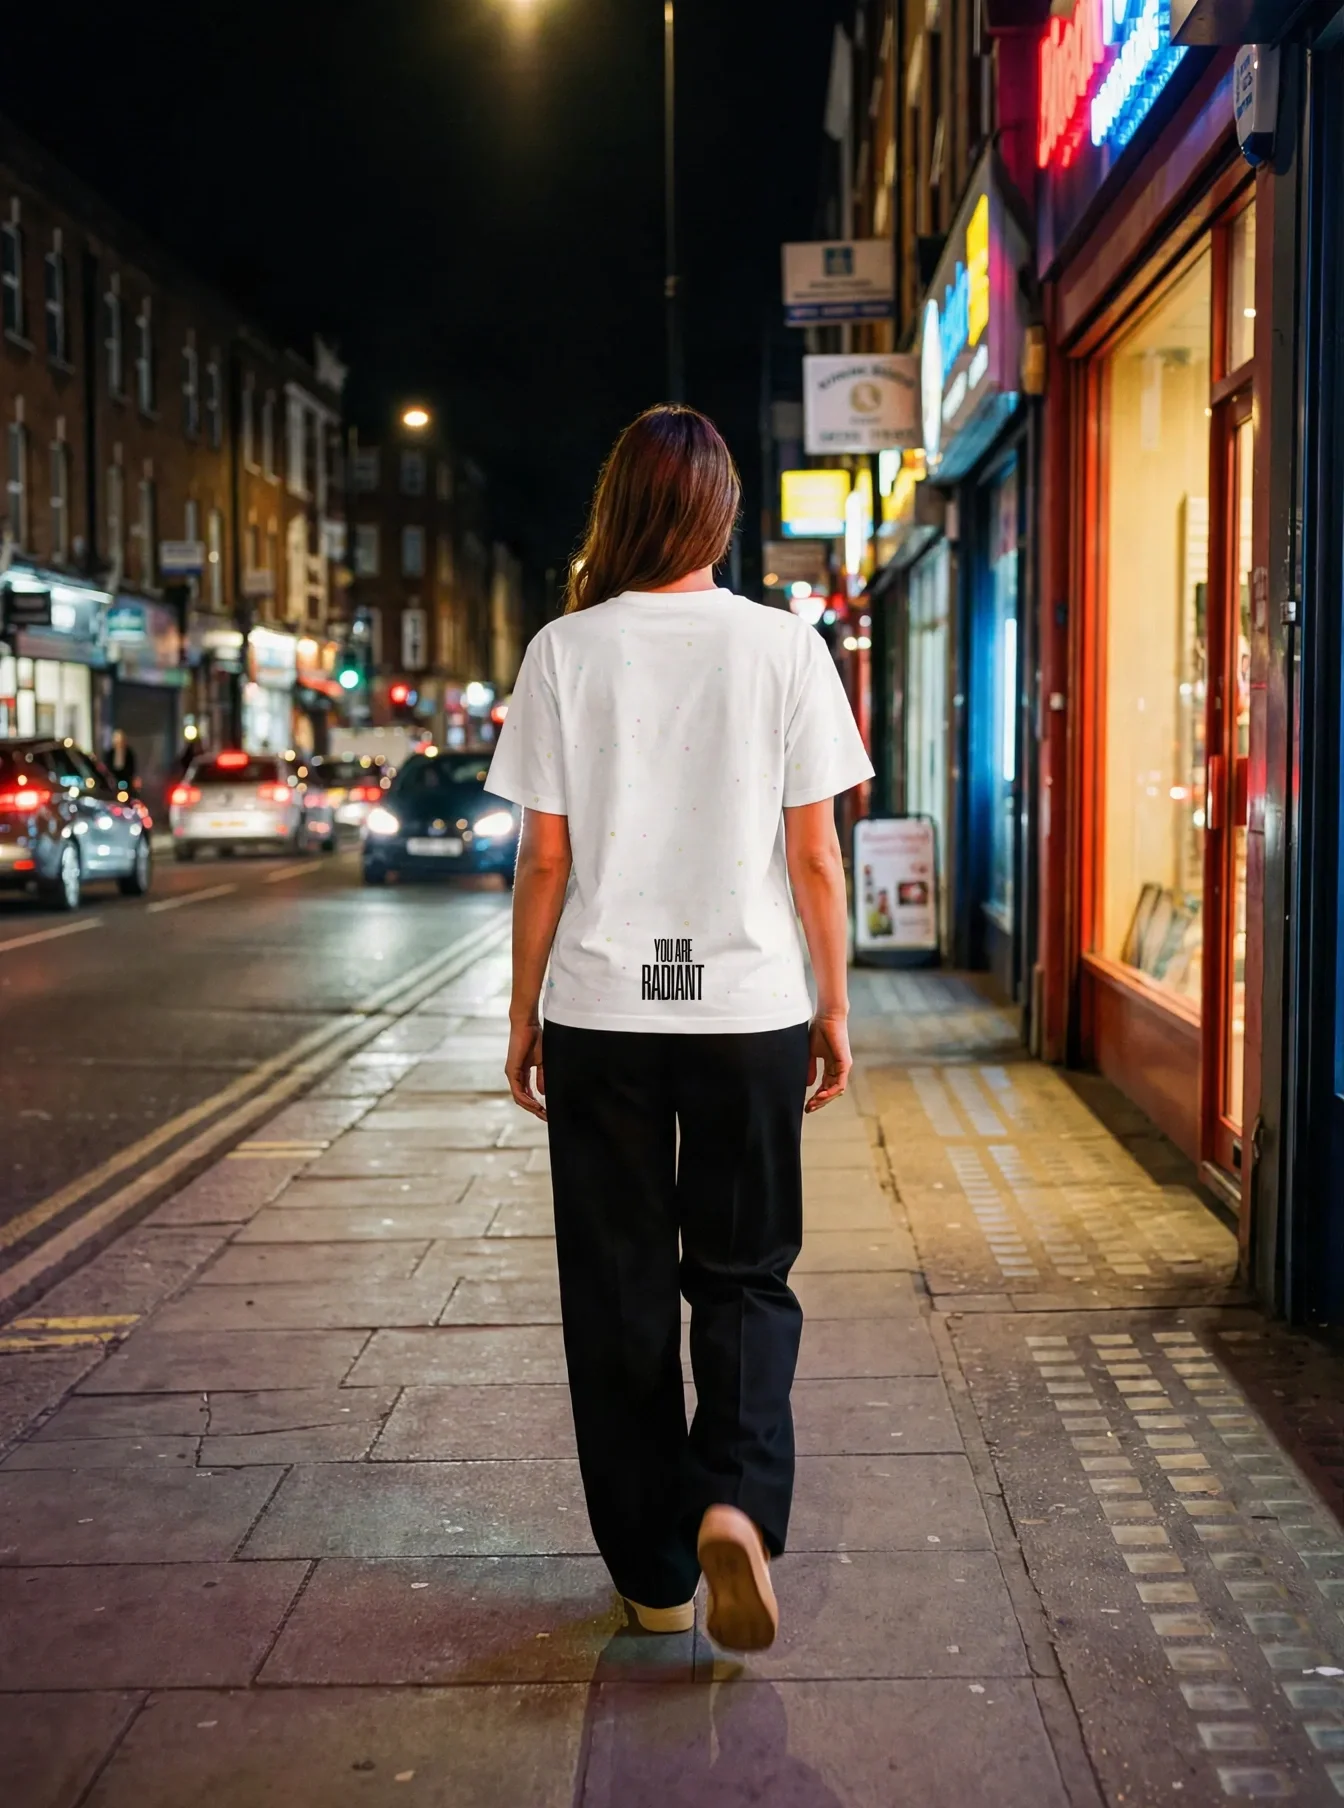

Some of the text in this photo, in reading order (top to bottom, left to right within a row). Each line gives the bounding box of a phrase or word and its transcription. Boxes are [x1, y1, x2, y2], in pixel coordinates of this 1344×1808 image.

[654, 939, 693, 962] YOU ARE
[642, 965, 704, 1000] RADIANT
